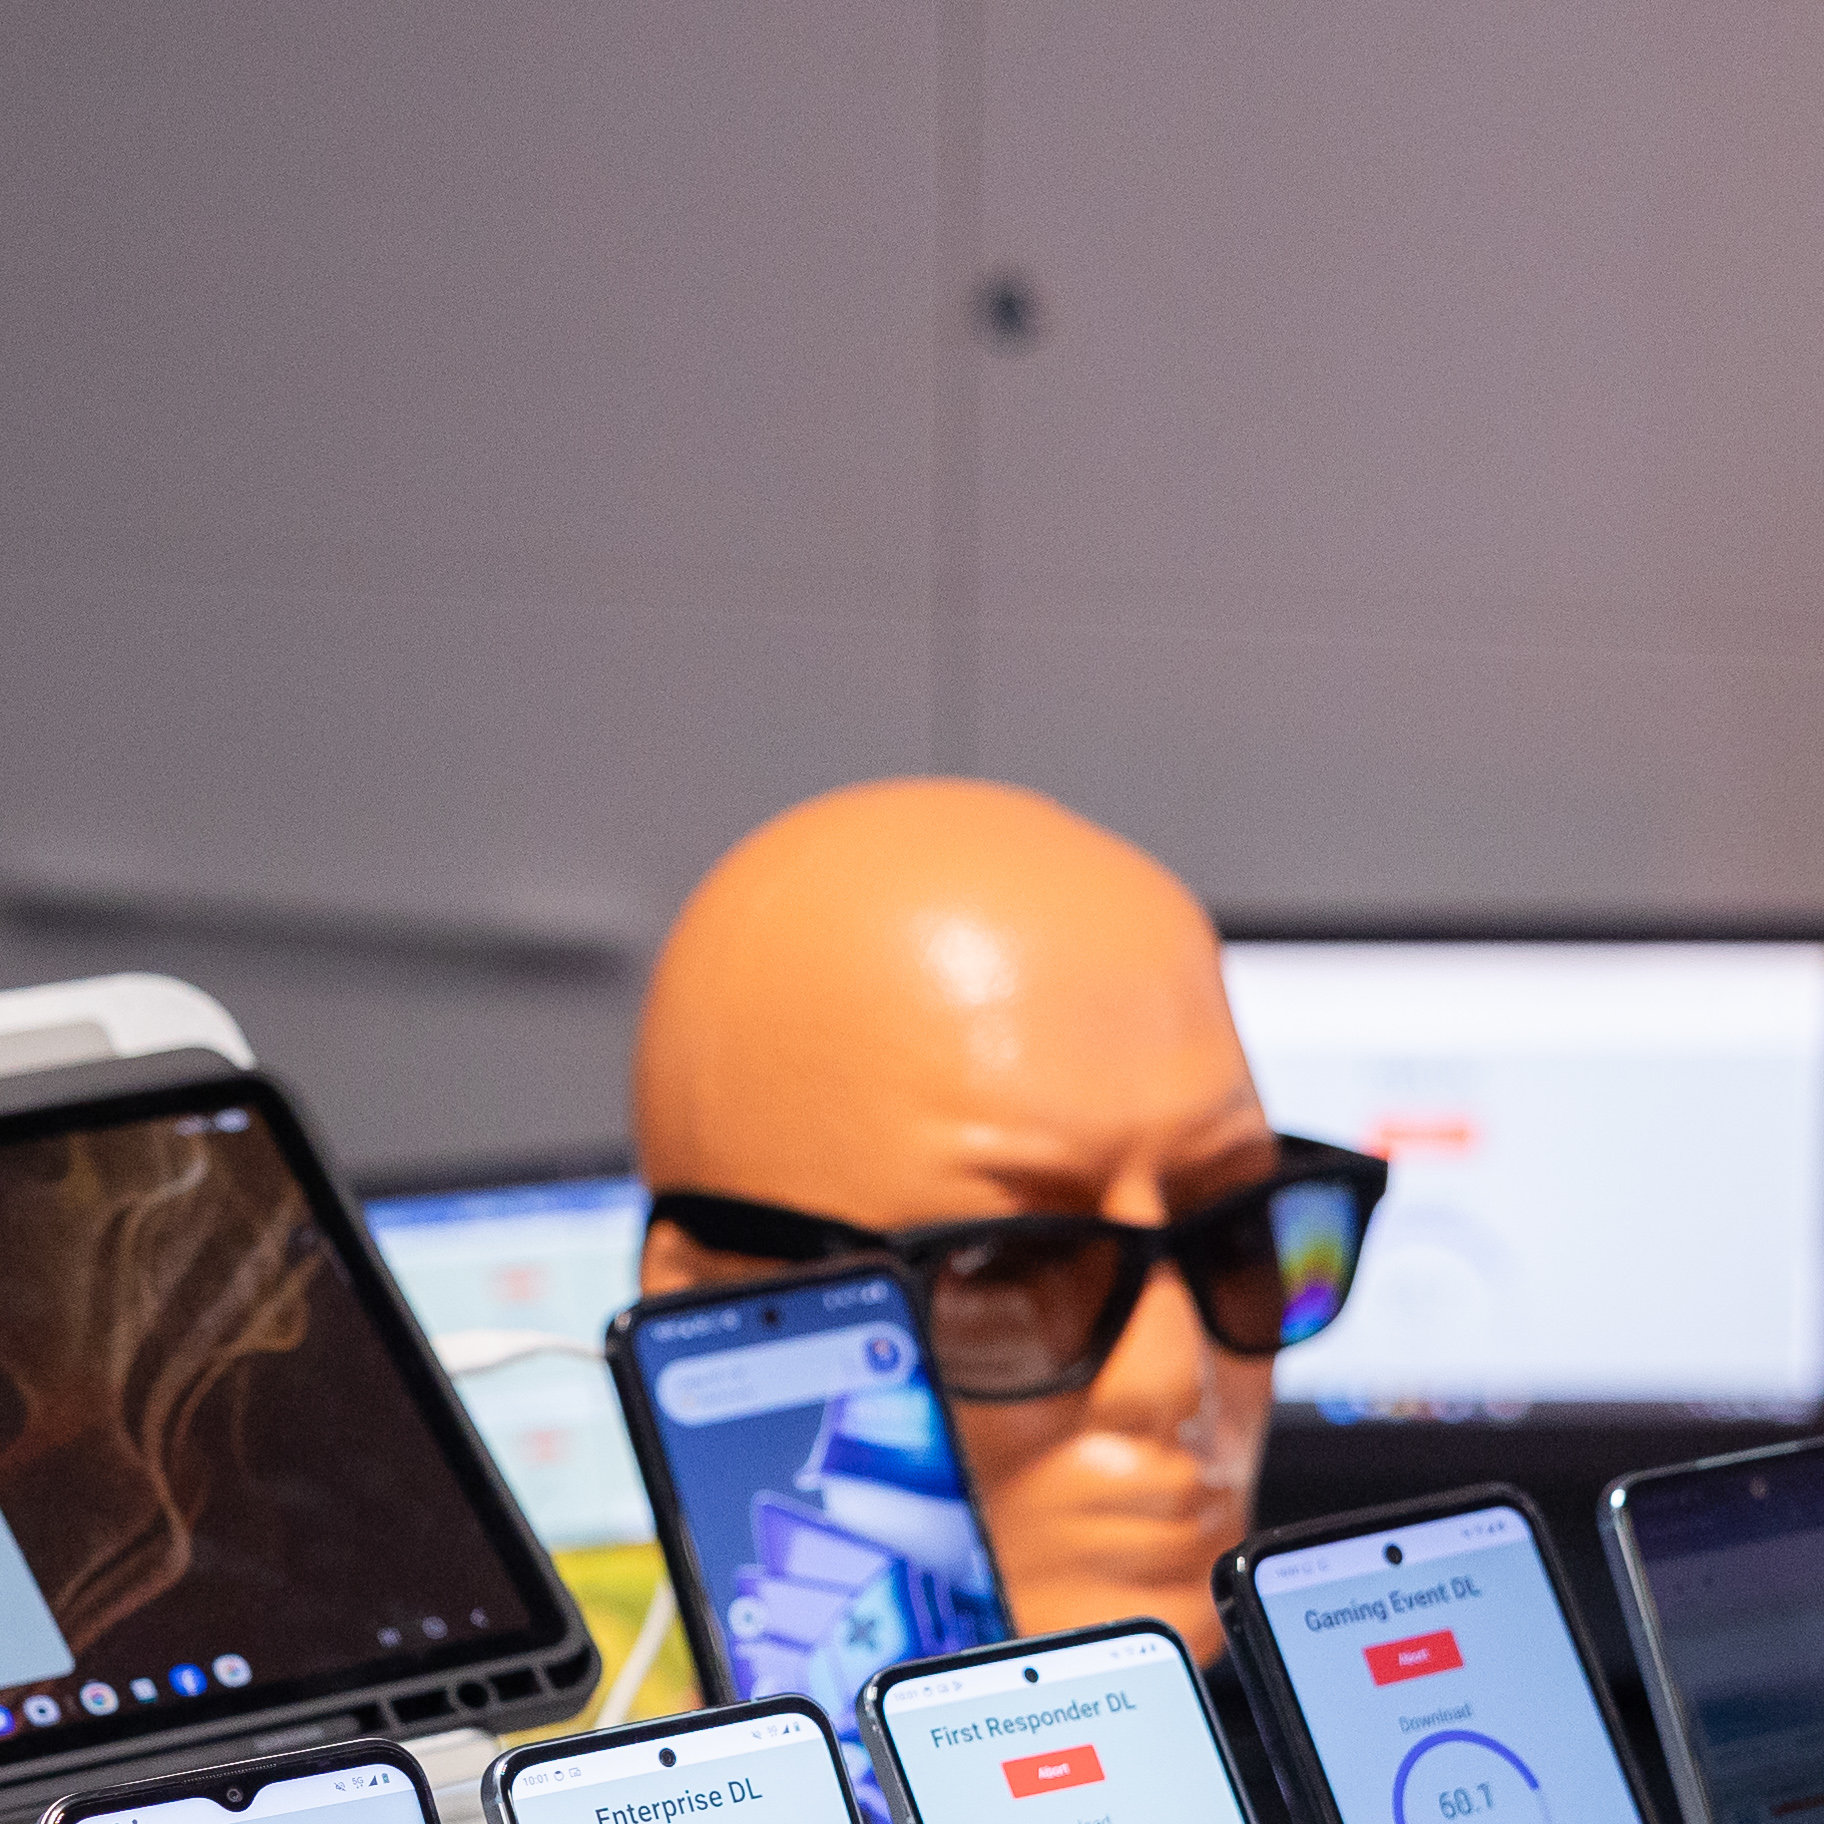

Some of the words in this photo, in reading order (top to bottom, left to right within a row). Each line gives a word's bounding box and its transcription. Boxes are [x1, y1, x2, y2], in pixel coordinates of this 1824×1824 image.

[1304, 1597, 1386, 1631] Gaming
[1388, 1585, 1447, 1612] Event
[1451, 1575, 1480, 1598] DL
[930, 1722, 981, 1747] First
[985, 1698, 1100, 1736] Responder
[1106, 1690, 1134, 1712] DL
[1398, 1704, 1471, 1732] Download
[522, 1771, 549, 1787] 10:01
[1037, 1761, 1069, 1778] Abort
[728, 1776, 761, 1802] DL
